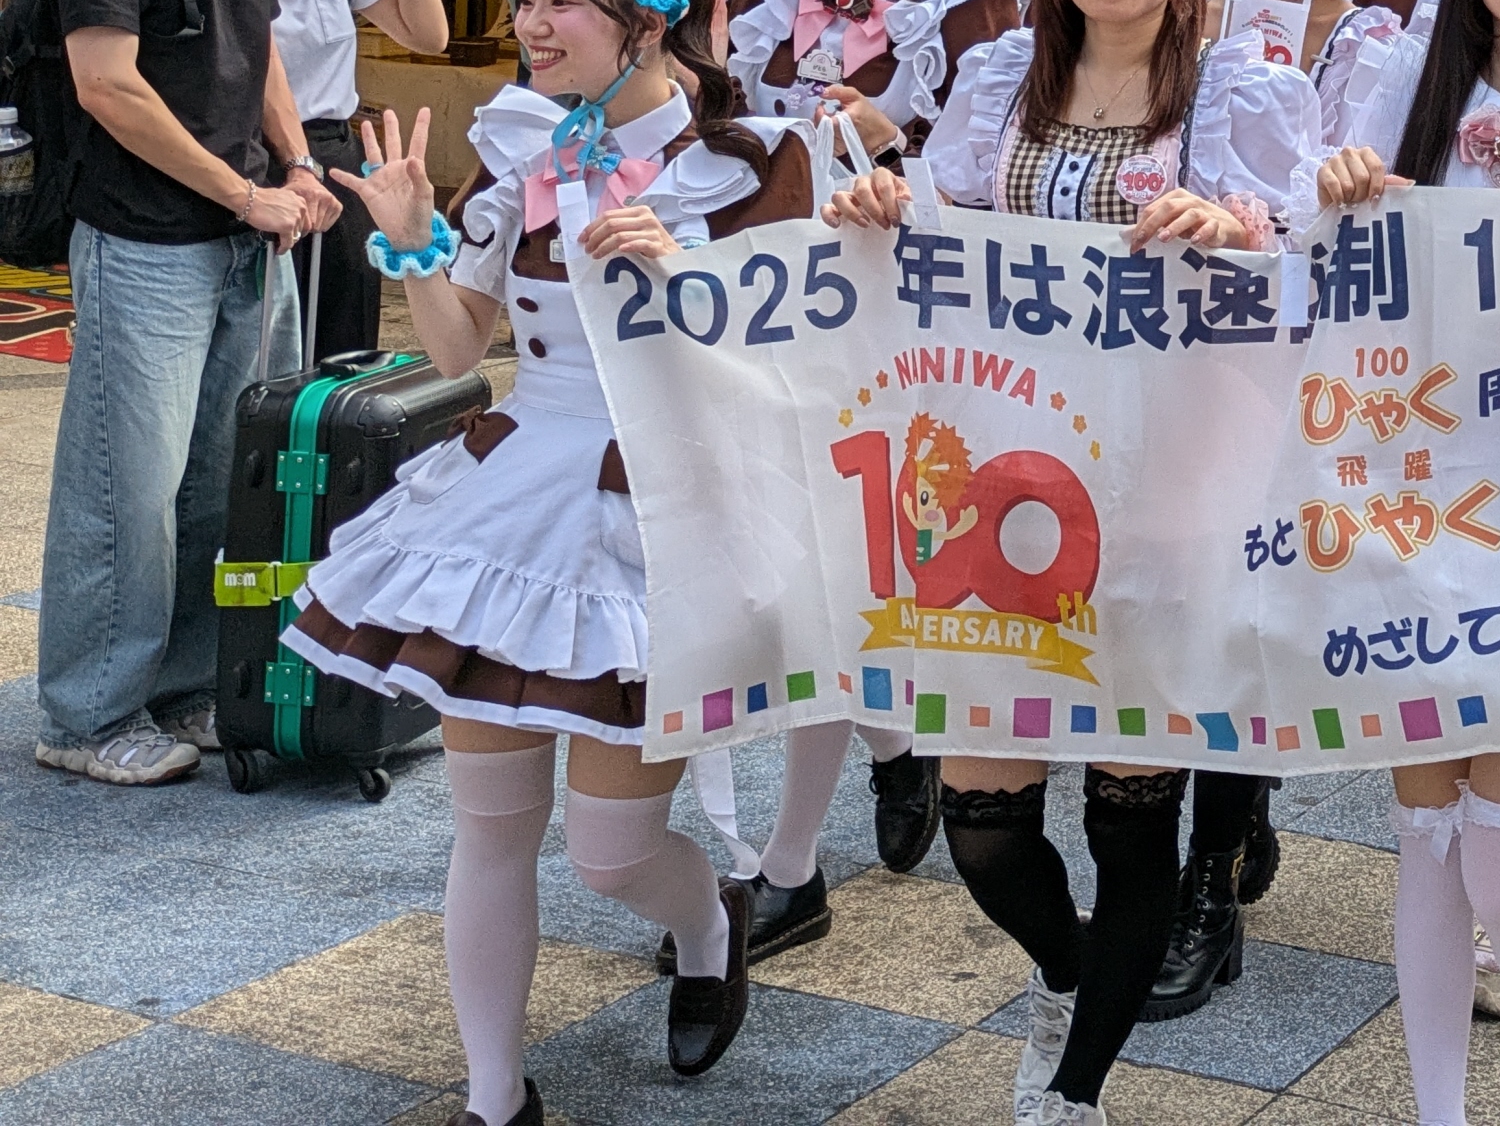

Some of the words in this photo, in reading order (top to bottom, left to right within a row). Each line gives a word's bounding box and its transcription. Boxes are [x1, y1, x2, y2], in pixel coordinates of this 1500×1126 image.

[1123, 170, 1163, 192] 100
[603, 240, 859, 347] 2025
[896, 211, 1410, 352] 年は浪速制
[1355, 346, 1409, 378] 100
[1056, 591, 1099, 636] th
